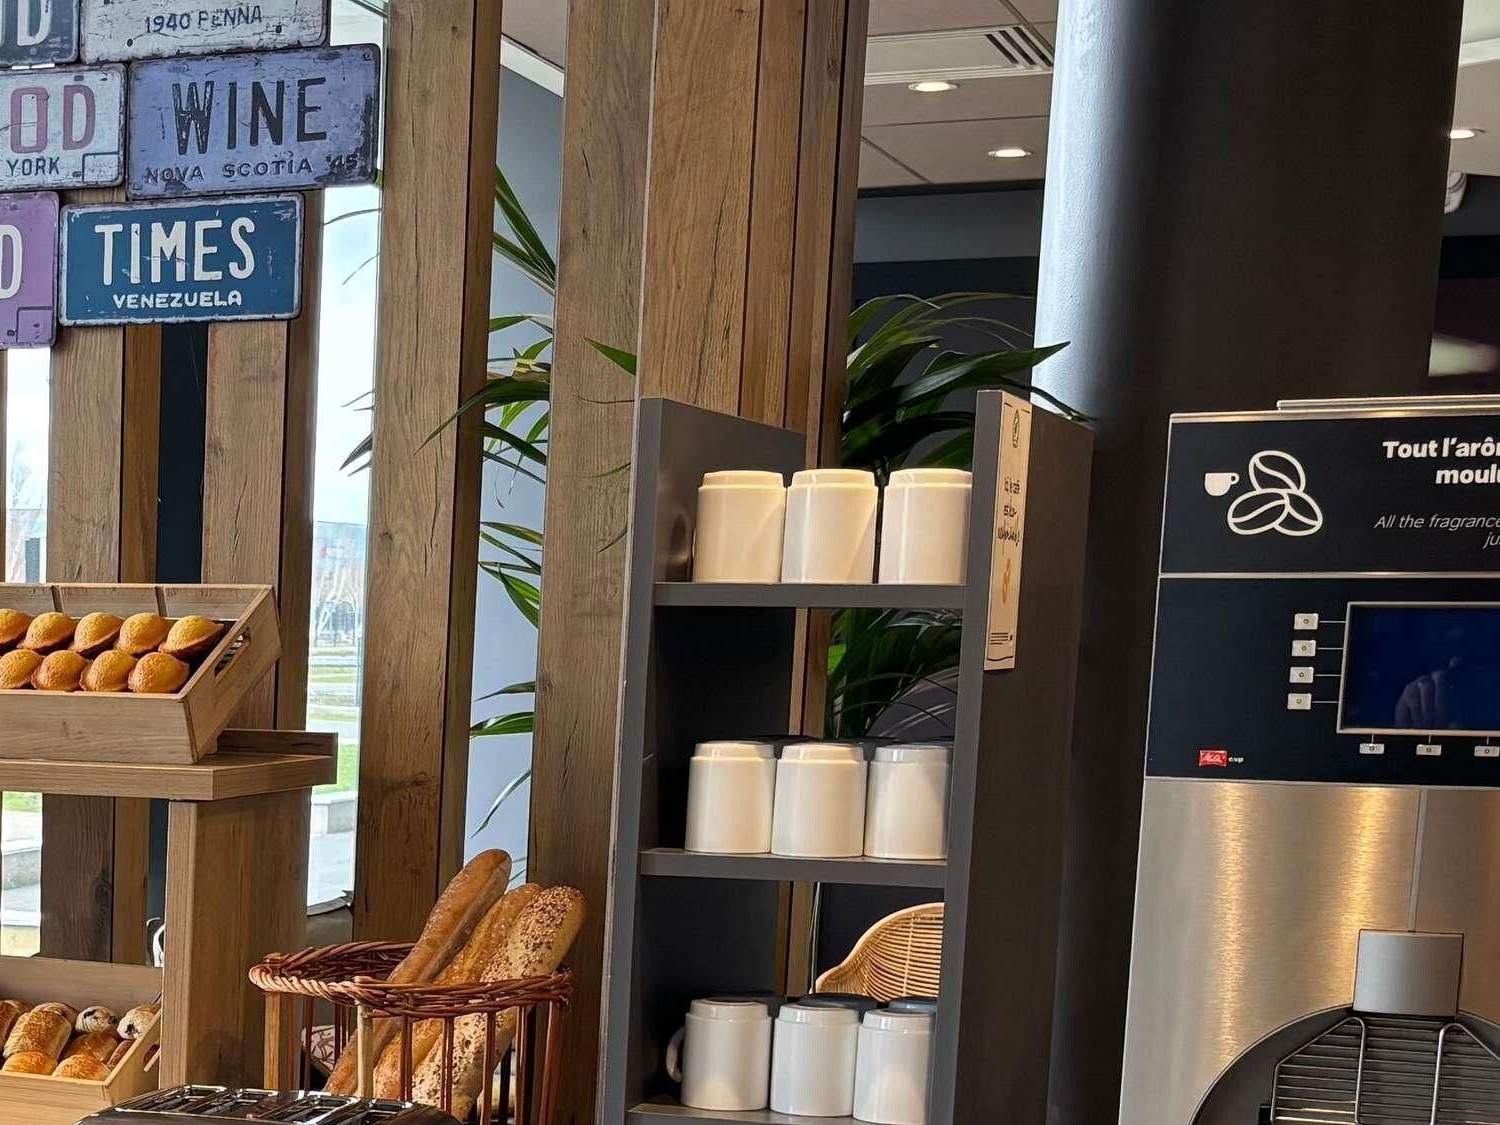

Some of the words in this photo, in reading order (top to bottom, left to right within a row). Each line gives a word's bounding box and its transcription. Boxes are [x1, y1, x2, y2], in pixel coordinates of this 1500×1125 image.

[145, 15, 191, 34] 1940
[172, 77, 328, 155] WINE
[7, 156, 61, 177] YORK
[144, 166, 205, 185] NOVA
[222, 157, 314, 179] SCOTIA
[94, 216, 256, 286] TIMES
[113, 289, 243, 310] VENEZUELA
[1382, 440, 1438, 459] Tout
[1442, 436, 1500, 458] l'arô
[1435, 463, 1500, 485] moul
[1373, 514, 1397, 529] All
[1399, 514, 1425, 529] the
[1482, 531, 1500, 549] ju
